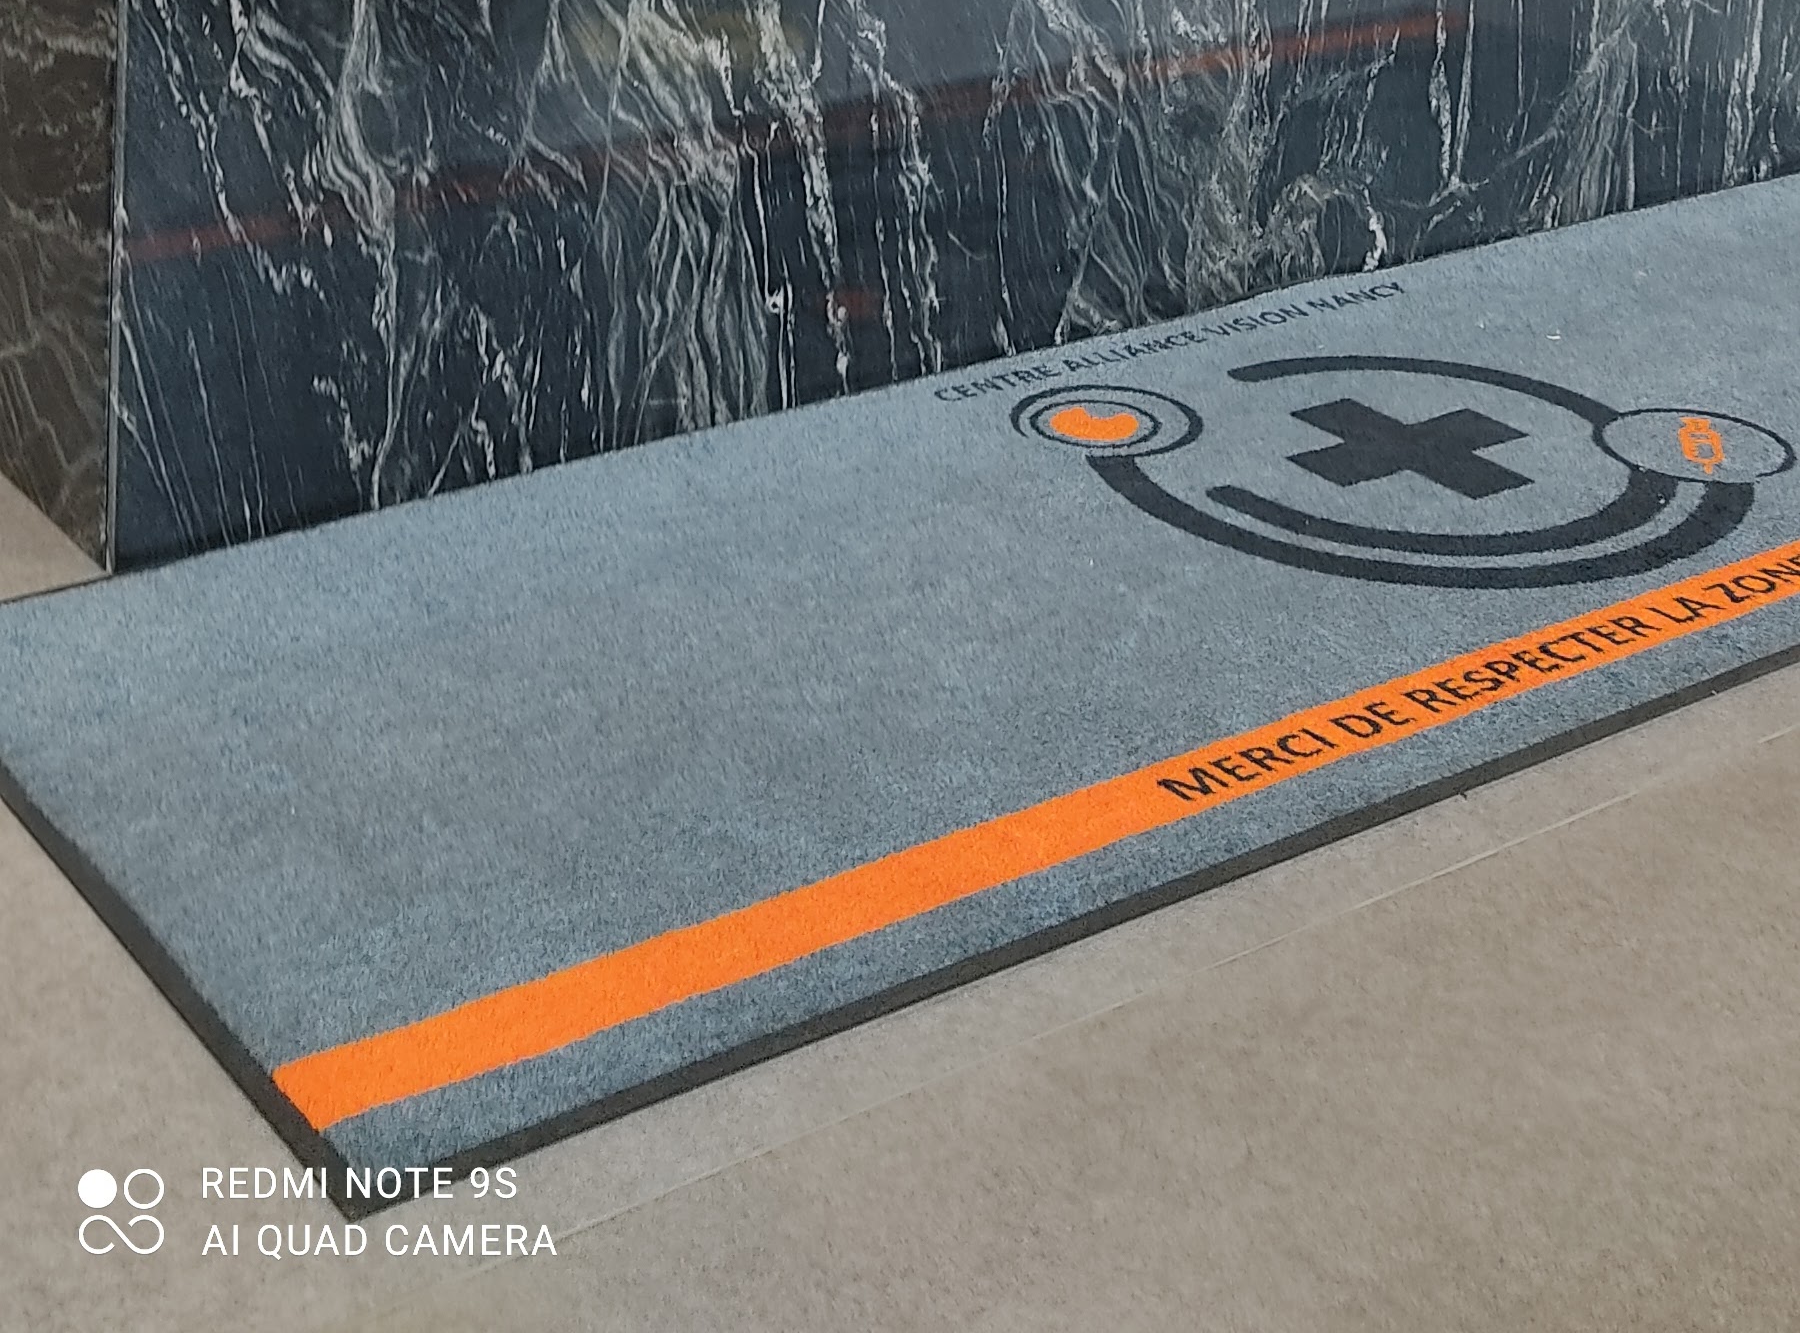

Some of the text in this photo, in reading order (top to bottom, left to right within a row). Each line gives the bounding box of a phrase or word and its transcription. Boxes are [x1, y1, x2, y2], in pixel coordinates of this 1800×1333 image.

[934, 281, 1405, 402] CENTRE ALLIANCE VISION NANCY
[1156, 727, 1340, 801] MERCI
[1328, 701, 1418, 739] DE
[1400, 615, 1664, 715] RESPECTER
[1645, 595, 1728, 625] LA
